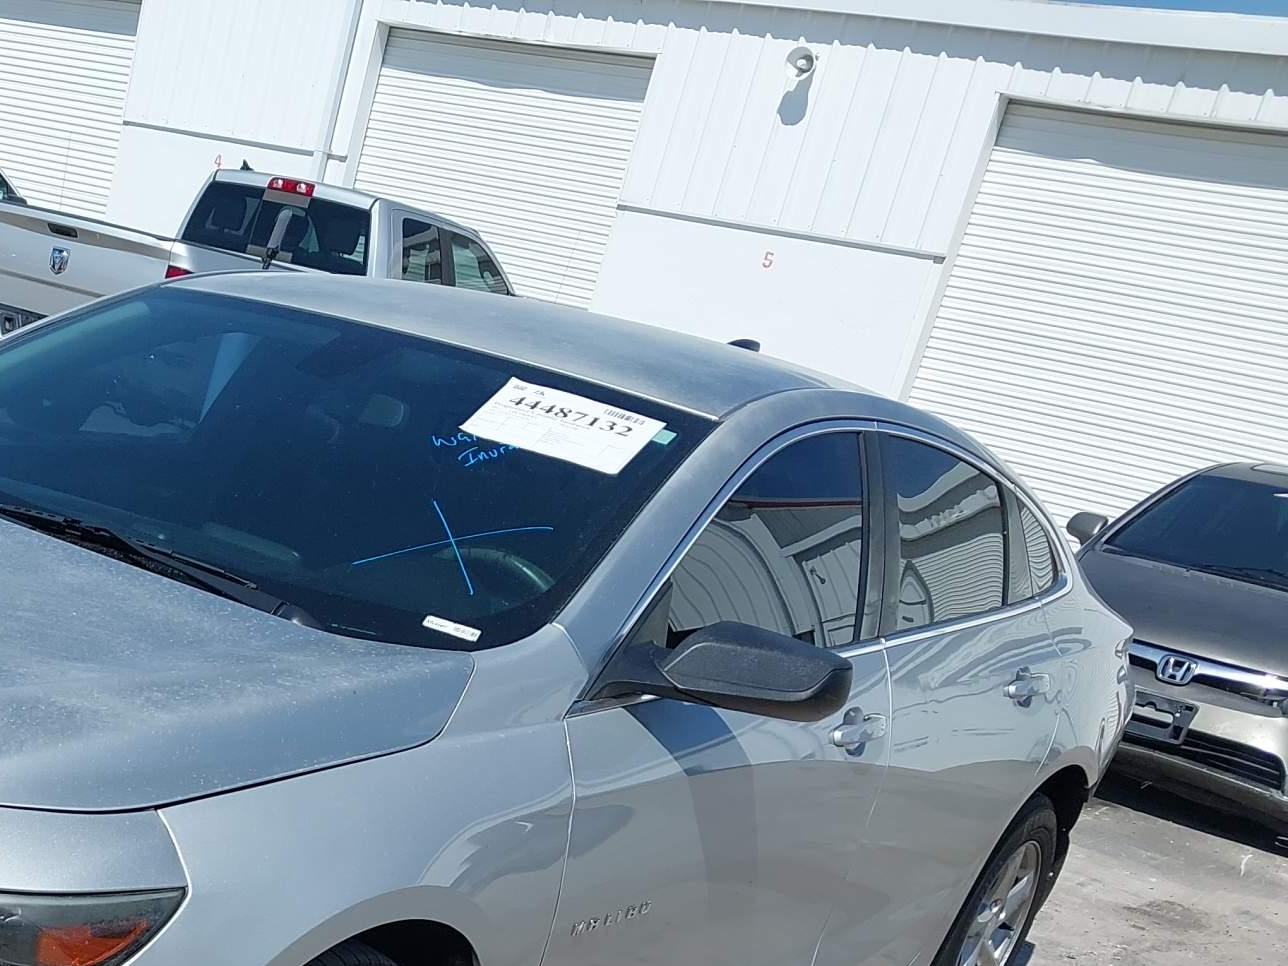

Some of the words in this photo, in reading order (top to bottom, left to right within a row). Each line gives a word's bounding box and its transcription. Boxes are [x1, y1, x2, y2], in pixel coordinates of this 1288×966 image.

[214, 153, 223, 168] 4
[762, 251, 774, 269] 5
[508, 396, 633, 437] 44487132
[570, 900, 652, 936] MALIBU
